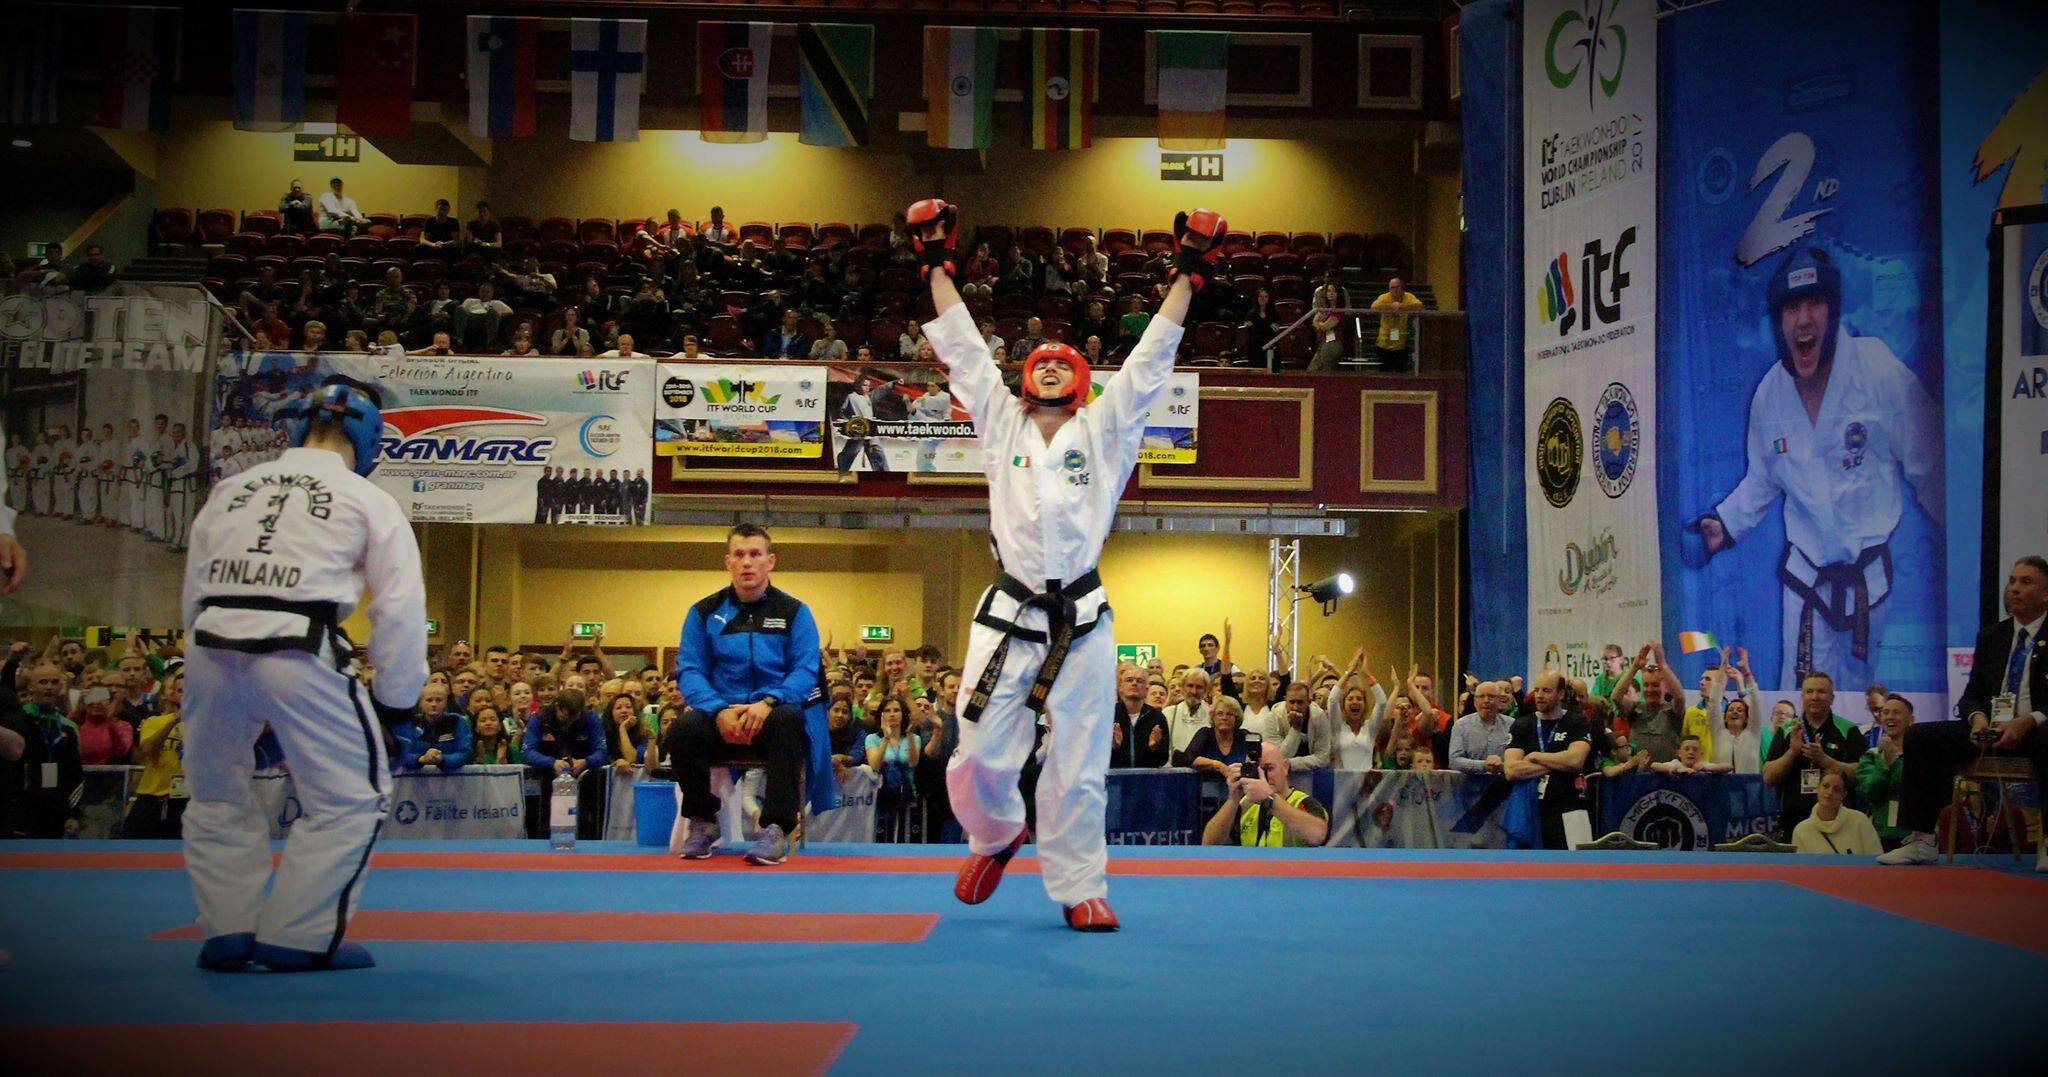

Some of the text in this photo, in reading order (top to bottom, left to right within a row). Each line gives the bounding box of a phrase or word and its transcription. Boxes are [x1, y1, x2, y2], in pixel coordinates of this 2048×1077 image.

[320, 137, 356, 157] 1H
[1186, 156, 1220, 176] 1H
[1542, 139, 1628, 185] WORLD CHAMPIONSHIP
[1542, 181, 1576, 210] DUBLIN
[85, 296, 210, 347] TEN
[445, 367, 513, 389] Argentina
[2012, 366, 2048, 400] AR
[409, 389, 480, 397] TAEKWONDO ITF
[707, 404, 777, 413] ITF WORLD CUP
[877, 423, 977, 436] www.taekwondo.
[377, 437, 553, 462] RANMARC
[676, 443, 803, 455] www.itfworldcup2018.com
[380, 469, 517, 480] www.gran-marc.com.ar
[428, 481, 485, 491] granmarc
[208, 559, 302, 588] FINLAND
[473, 803, 519, 819] Ireland
[1110, 829, 1193, 846] HTYFIST
